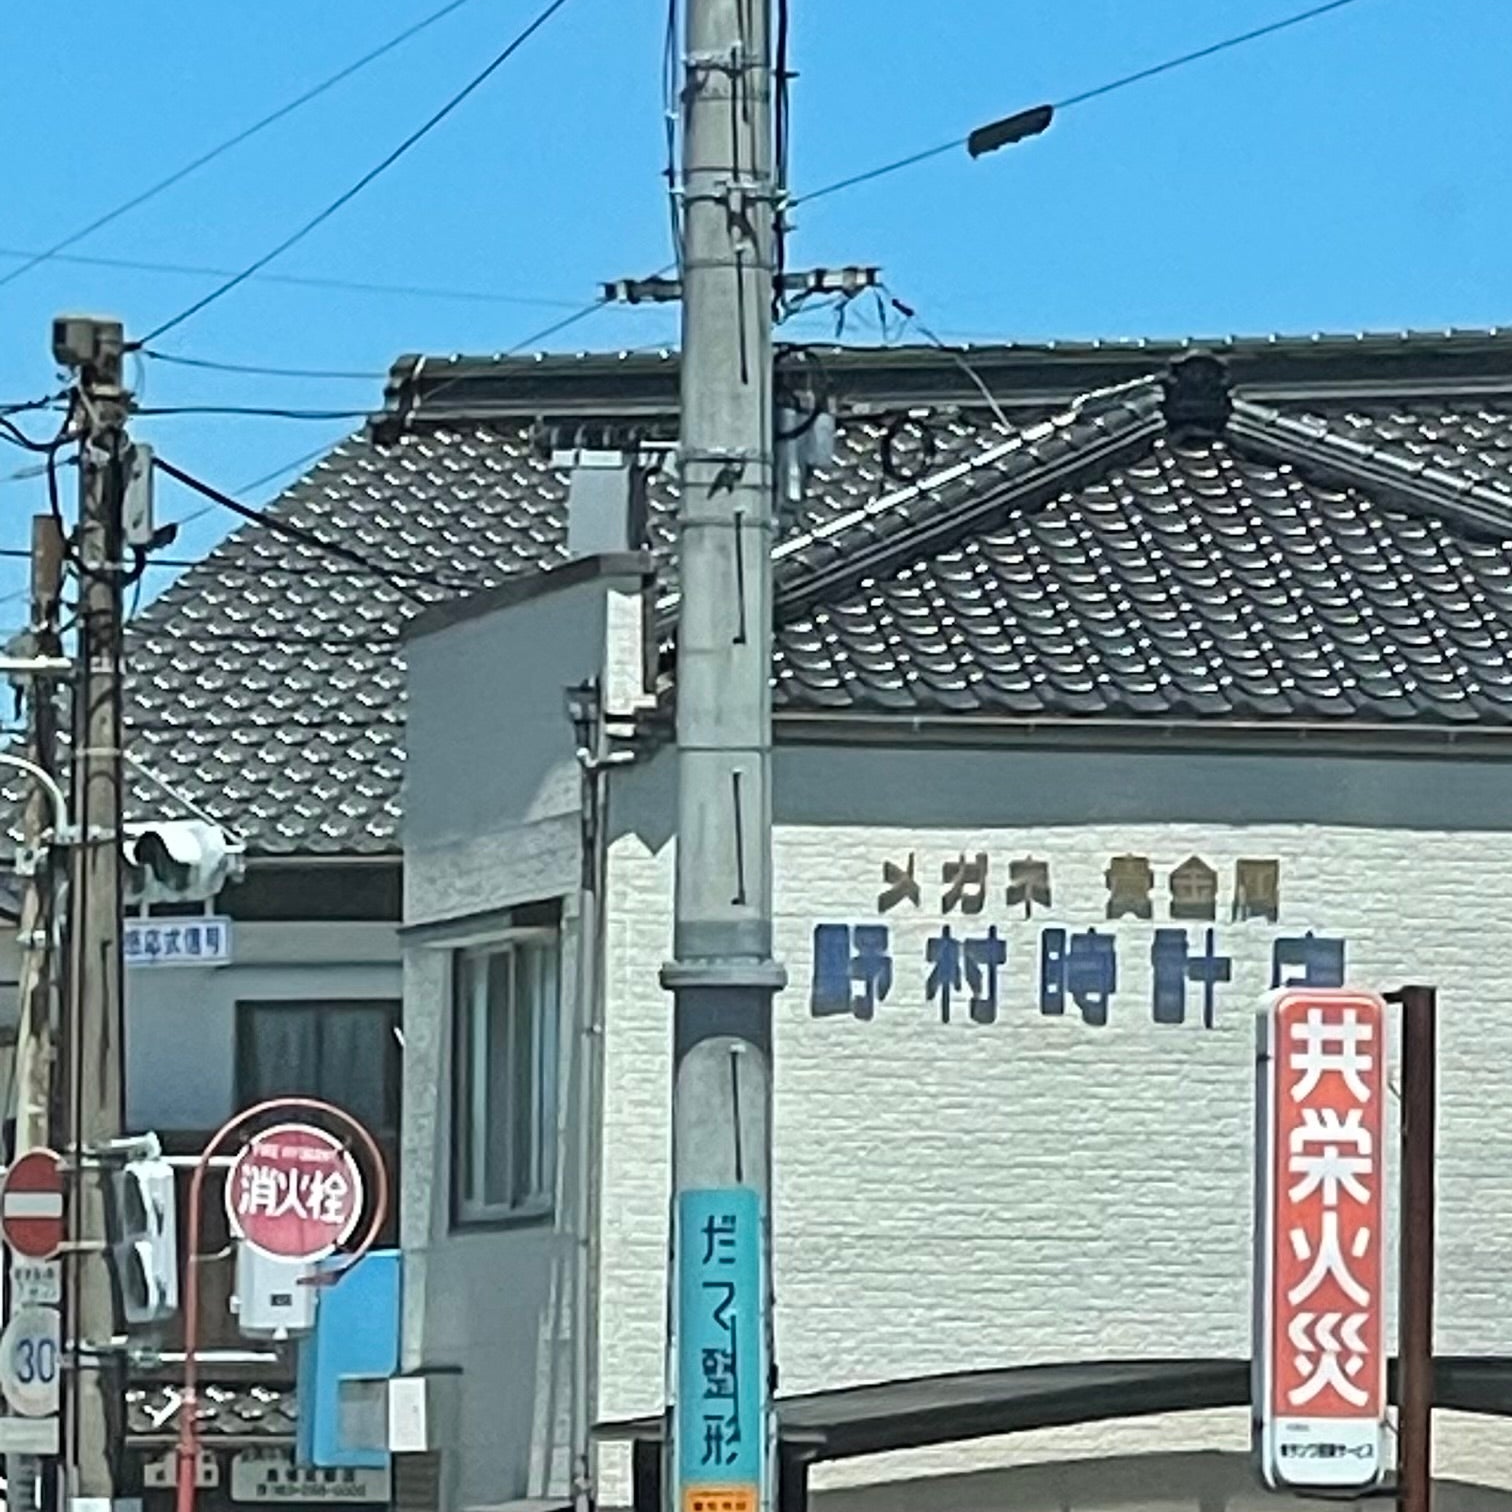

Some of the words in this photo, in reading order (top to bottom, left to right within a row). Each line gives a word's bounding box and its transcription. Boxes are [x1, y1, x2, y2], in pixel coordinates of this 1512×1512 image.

[878, 852, 1052, 919] メガネ
[1105, 854, 1280, 922] 貴金属
[237, 1163, 348, 1224] 消火栓
[1288, 1007, 1373, 1408] 共栄火災
[16, 1339, 57, 1384] 30
